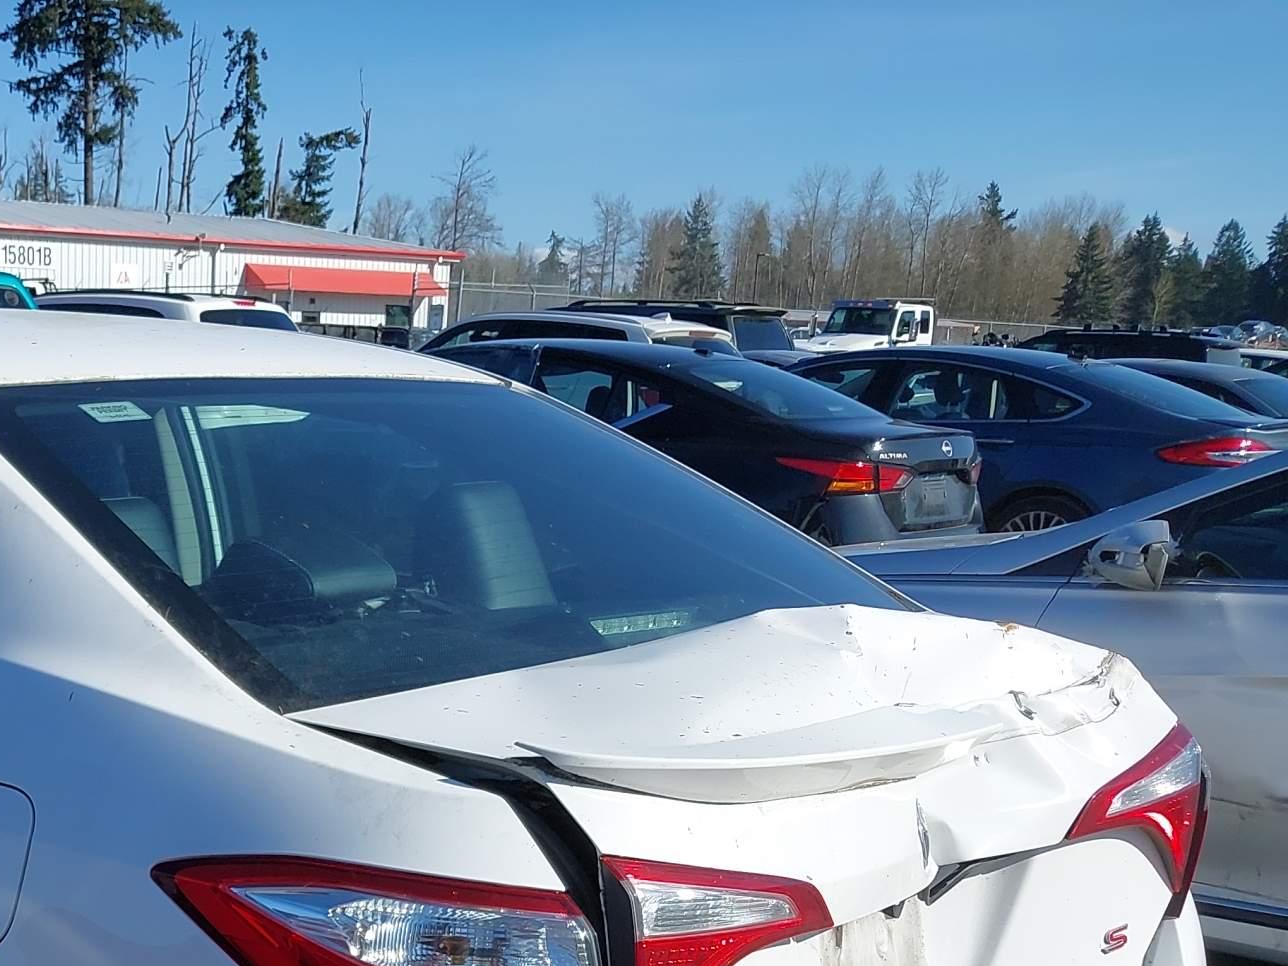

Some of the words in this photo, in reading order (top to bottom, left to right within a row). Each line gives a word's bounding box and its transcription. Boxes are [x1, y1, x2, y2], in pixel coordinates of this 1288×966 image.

[1, 244, 52, 266] 15801B
[879, 452, 909, 460] ALTIMA
[1100, 923, 1129, 955] S
